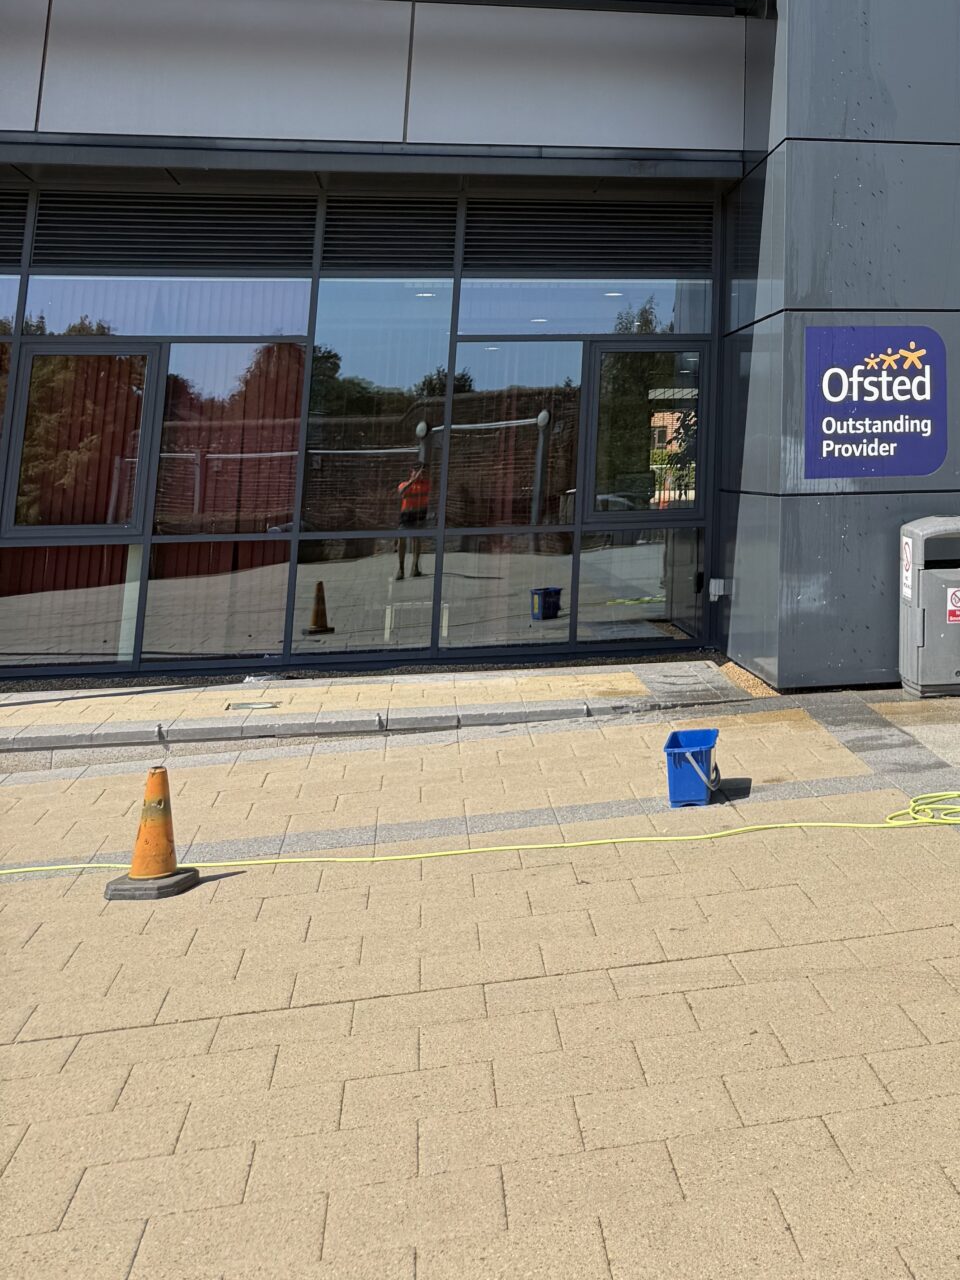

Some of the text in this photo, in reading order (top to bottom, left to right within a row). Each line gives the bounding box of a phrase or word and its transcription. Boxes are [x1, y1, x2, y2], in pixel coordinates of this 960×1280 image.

[821, 365, 932, 403] Ofsted
[821, 415, 932, 436] Outstanding
[822, 439, 897, 457] Provider
